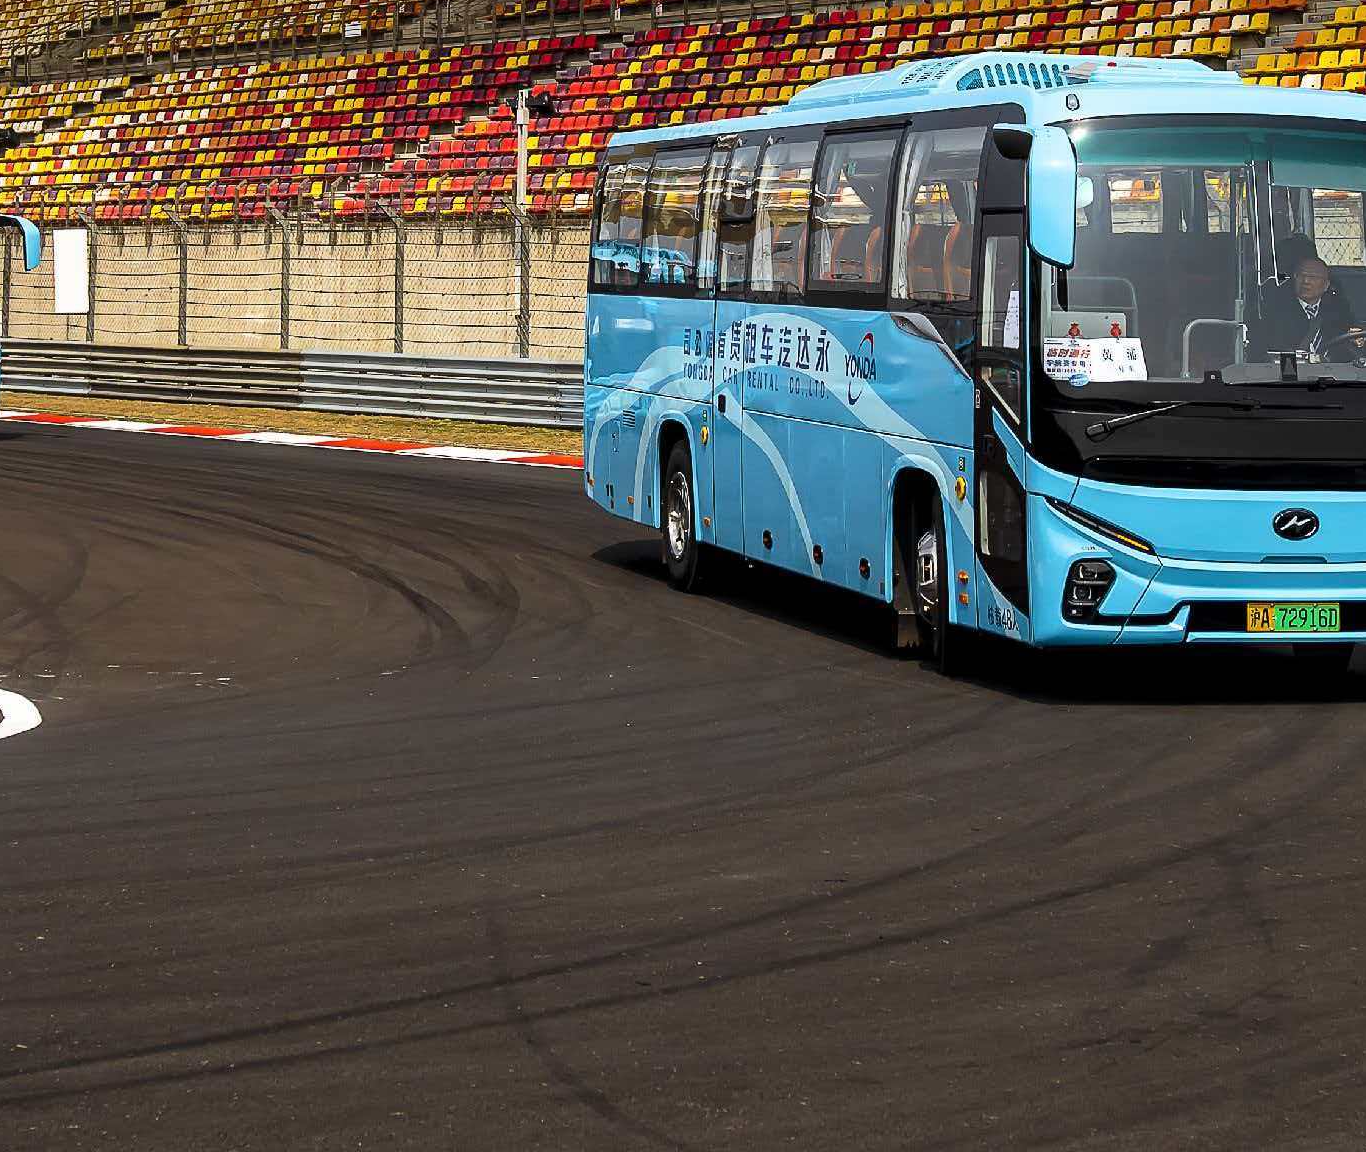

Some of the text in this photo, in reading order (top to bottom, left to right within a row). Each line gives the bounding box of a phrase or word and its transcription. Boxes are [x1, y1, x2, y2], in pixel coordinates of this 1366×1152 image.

[722, 366, 738, 385] CAR
[747, 370, 779, 392] RENTAL
[844, 354, 877, 381] YONDA
